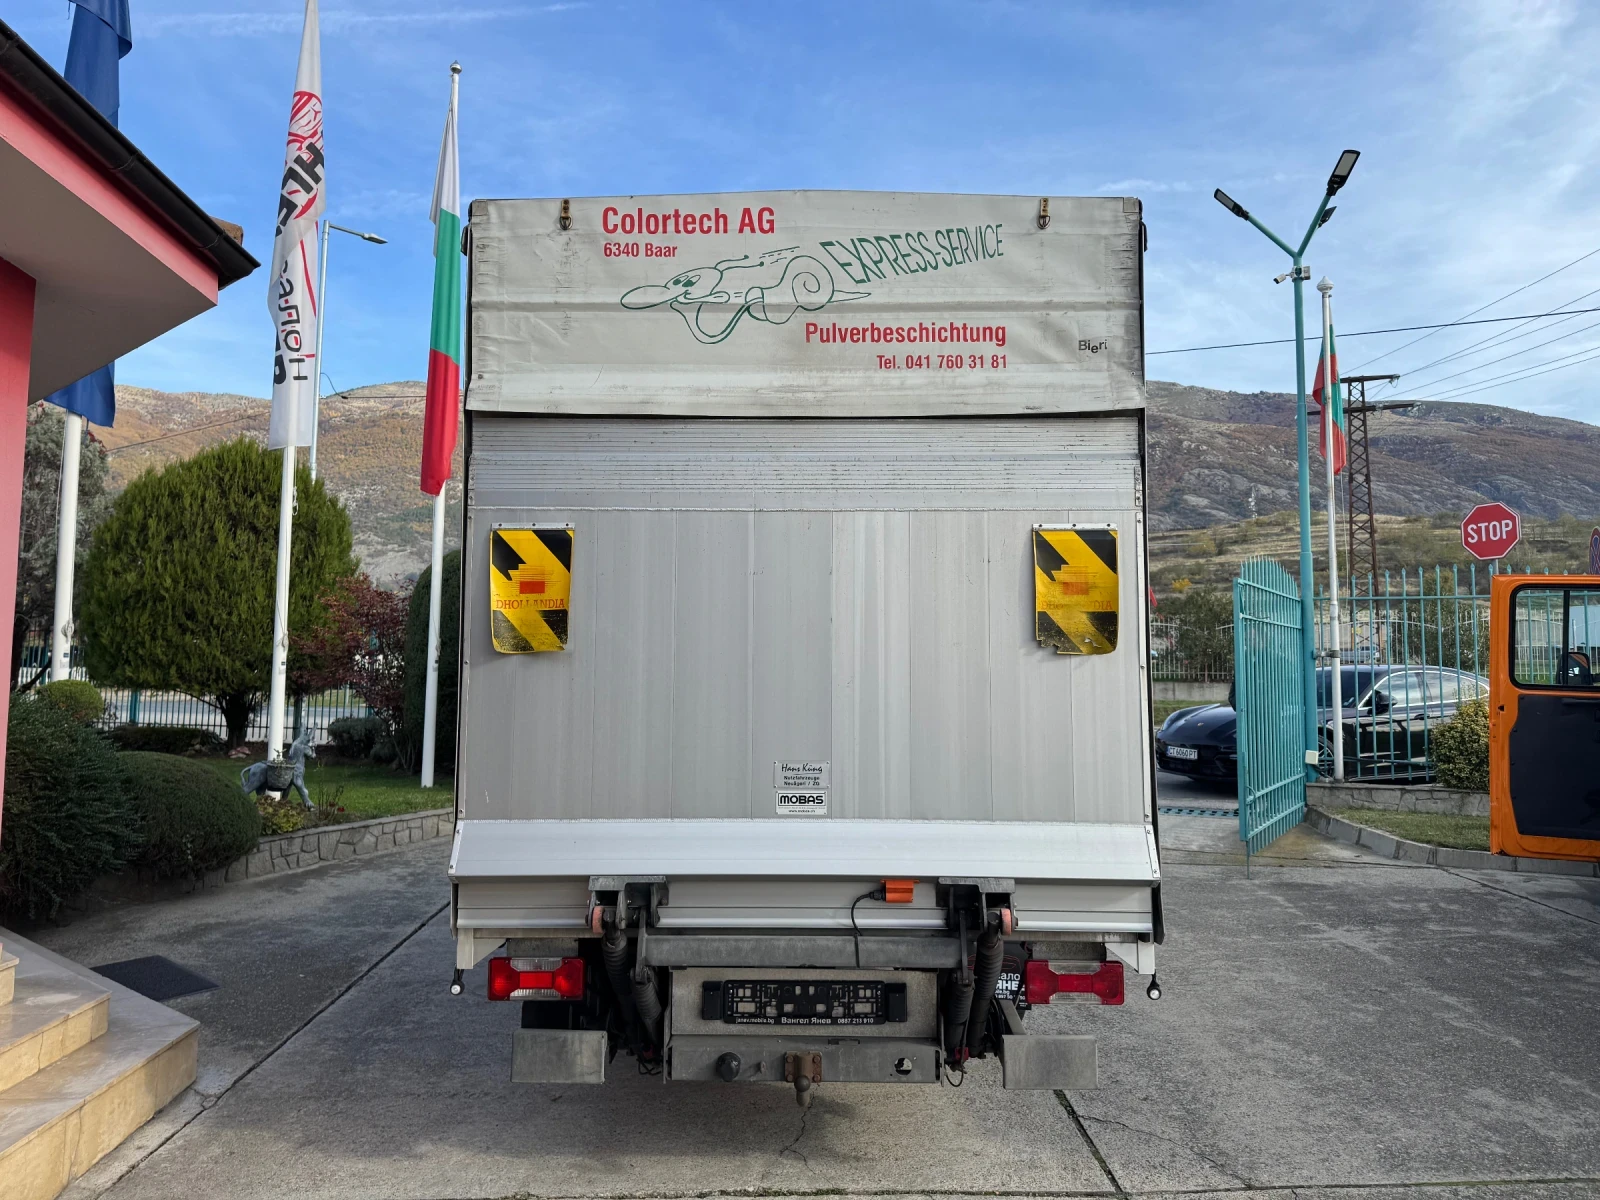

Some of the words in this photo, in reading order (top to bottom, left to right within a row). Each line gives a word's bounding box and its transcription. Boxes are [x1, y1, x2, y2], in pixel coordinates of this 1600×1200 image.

[602, 206, 729, 235] Colortech
[738, 206, 775, 235] AG
[603, 242, 640, 257] 6340
[644, 242, 678, 257] Baar
[819, 223, 1004, 284] EXPRESS-SERVICE
[805, 322, 1007, 347] Pulverbeschichtung
[1078, 339, 1108, 354] Bieri
[877, 355, 901, 370] Tel.
[905, 354, 931, 369] 041
[937, 354, 964, 369] 760
[968, 354, 985, 369] 31
[991, 354, 1007, 369] 81
[1467, 519, 1513, 543] STOP
[781, 763, 801, 772] Hans
[780, 795, 824, 804] MOBAS
[996, 980, 1020, 991] ЯНЕ
[781, 1016, 809, 1024] Вангел
